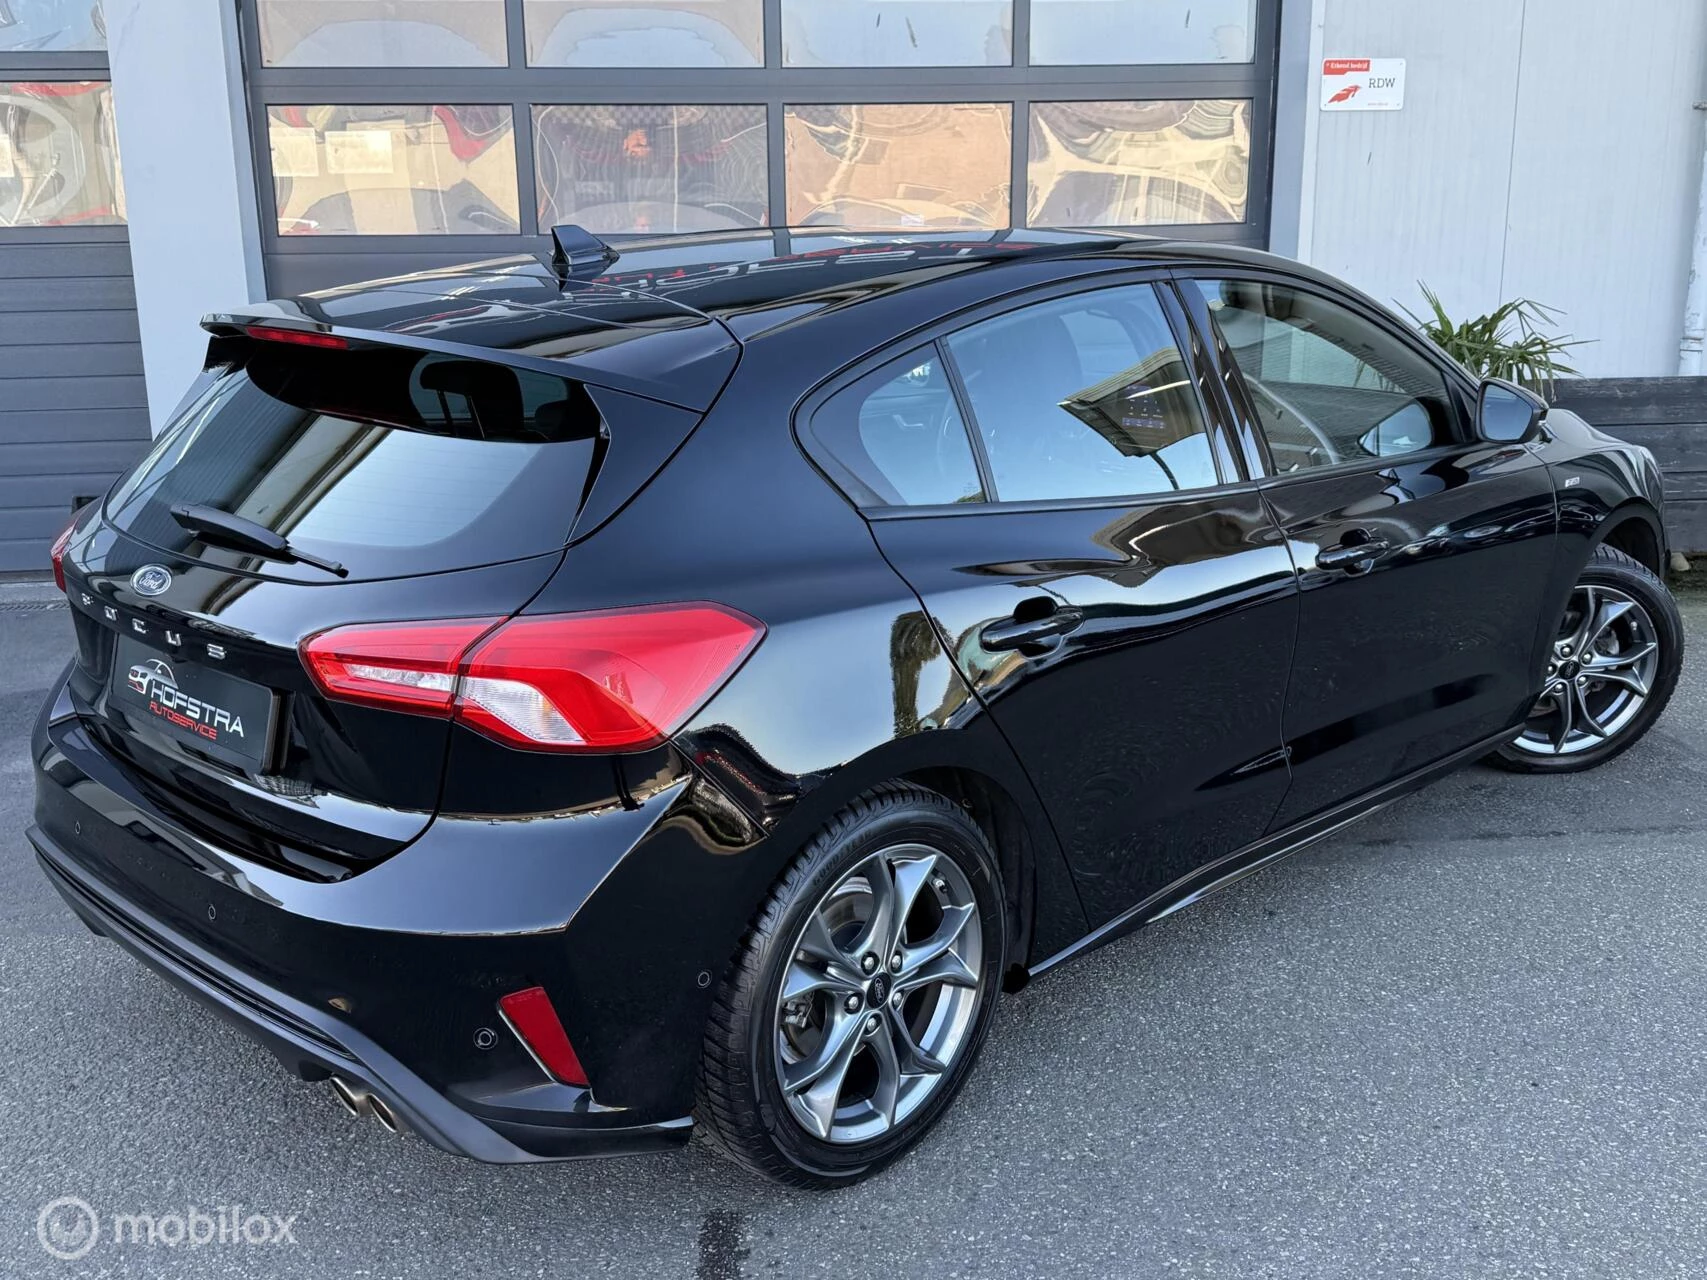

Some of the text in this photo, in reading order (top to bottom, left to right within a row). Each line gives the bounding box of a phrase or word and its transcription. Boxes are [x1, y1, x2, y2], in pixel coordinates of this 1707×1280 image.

[1368, 77, 1396, 89] RDW
[149, 700, 217, 740] AUTOSERVICE
[150, 680, 245, 738] HOFSTRA
